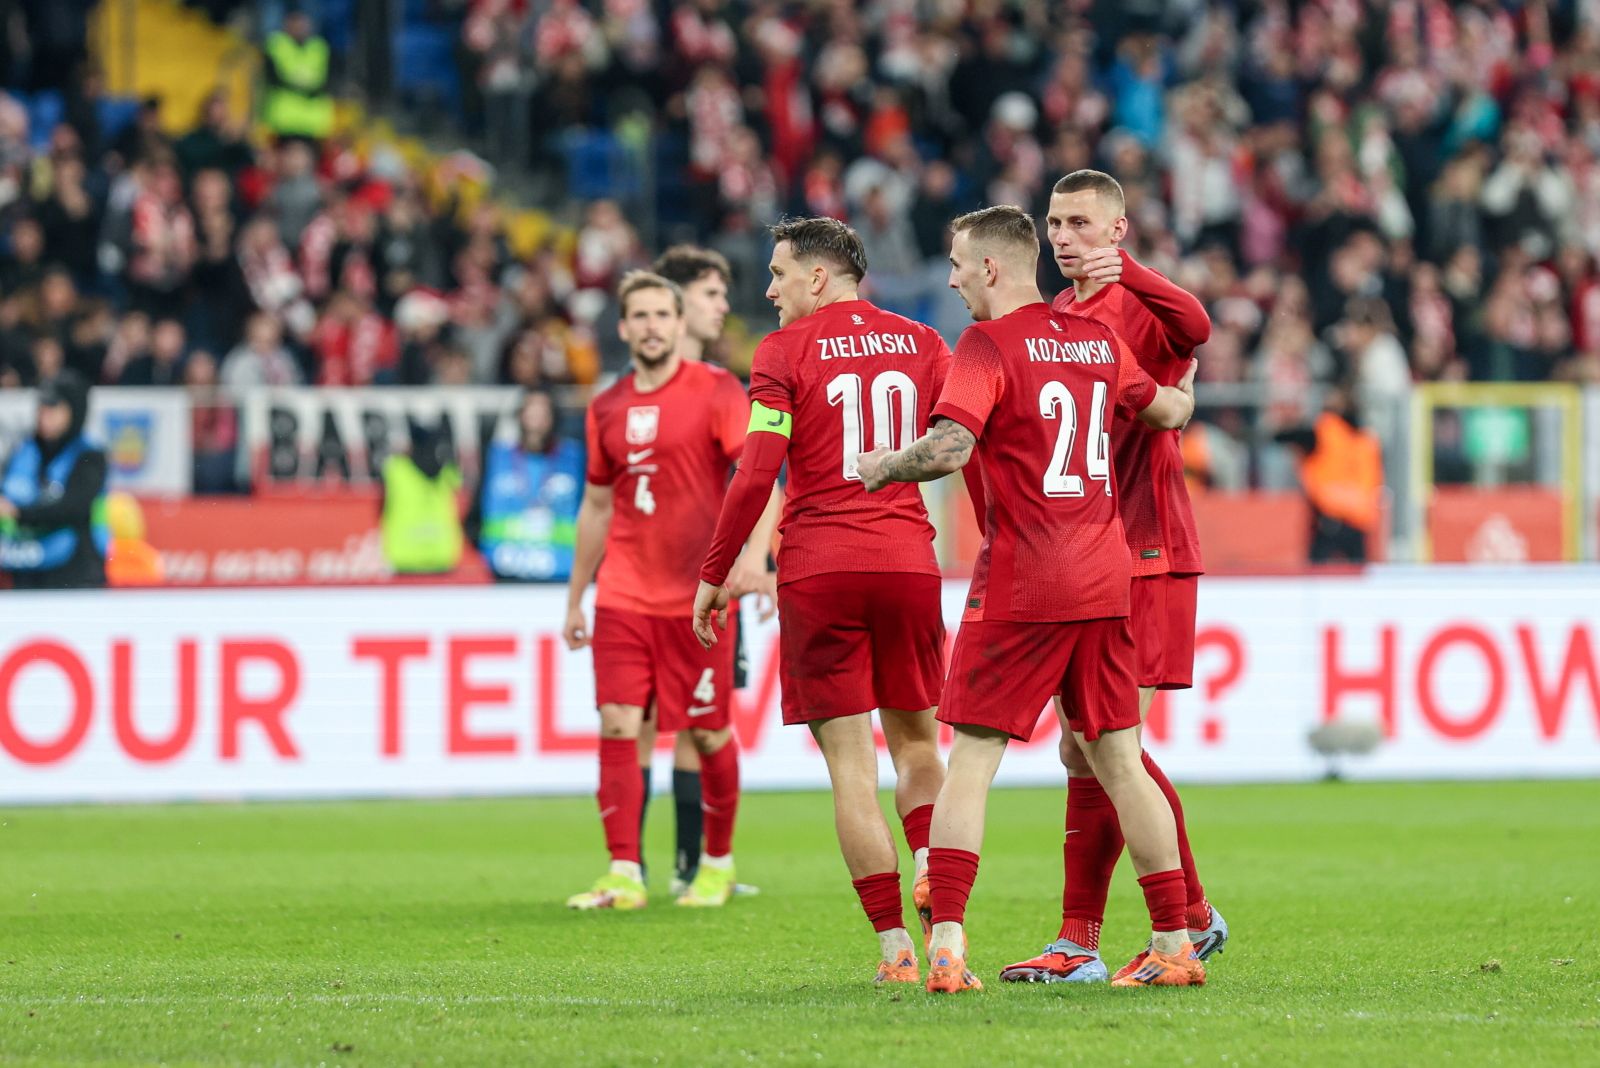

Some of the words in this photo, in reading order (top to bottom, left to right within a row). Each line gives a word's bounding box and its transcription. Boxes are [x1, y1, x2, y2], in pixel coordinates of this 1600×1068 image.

[817, 331, 918, 361] ZIELIŃSKI
[826, 370, 919, 481] 10
[1038, 380, 1113, 498] 24
[634, 474, 656, 516] 4
[694, 667, 716, 704] 4
[1321, 622, 1600, 745] HOW
